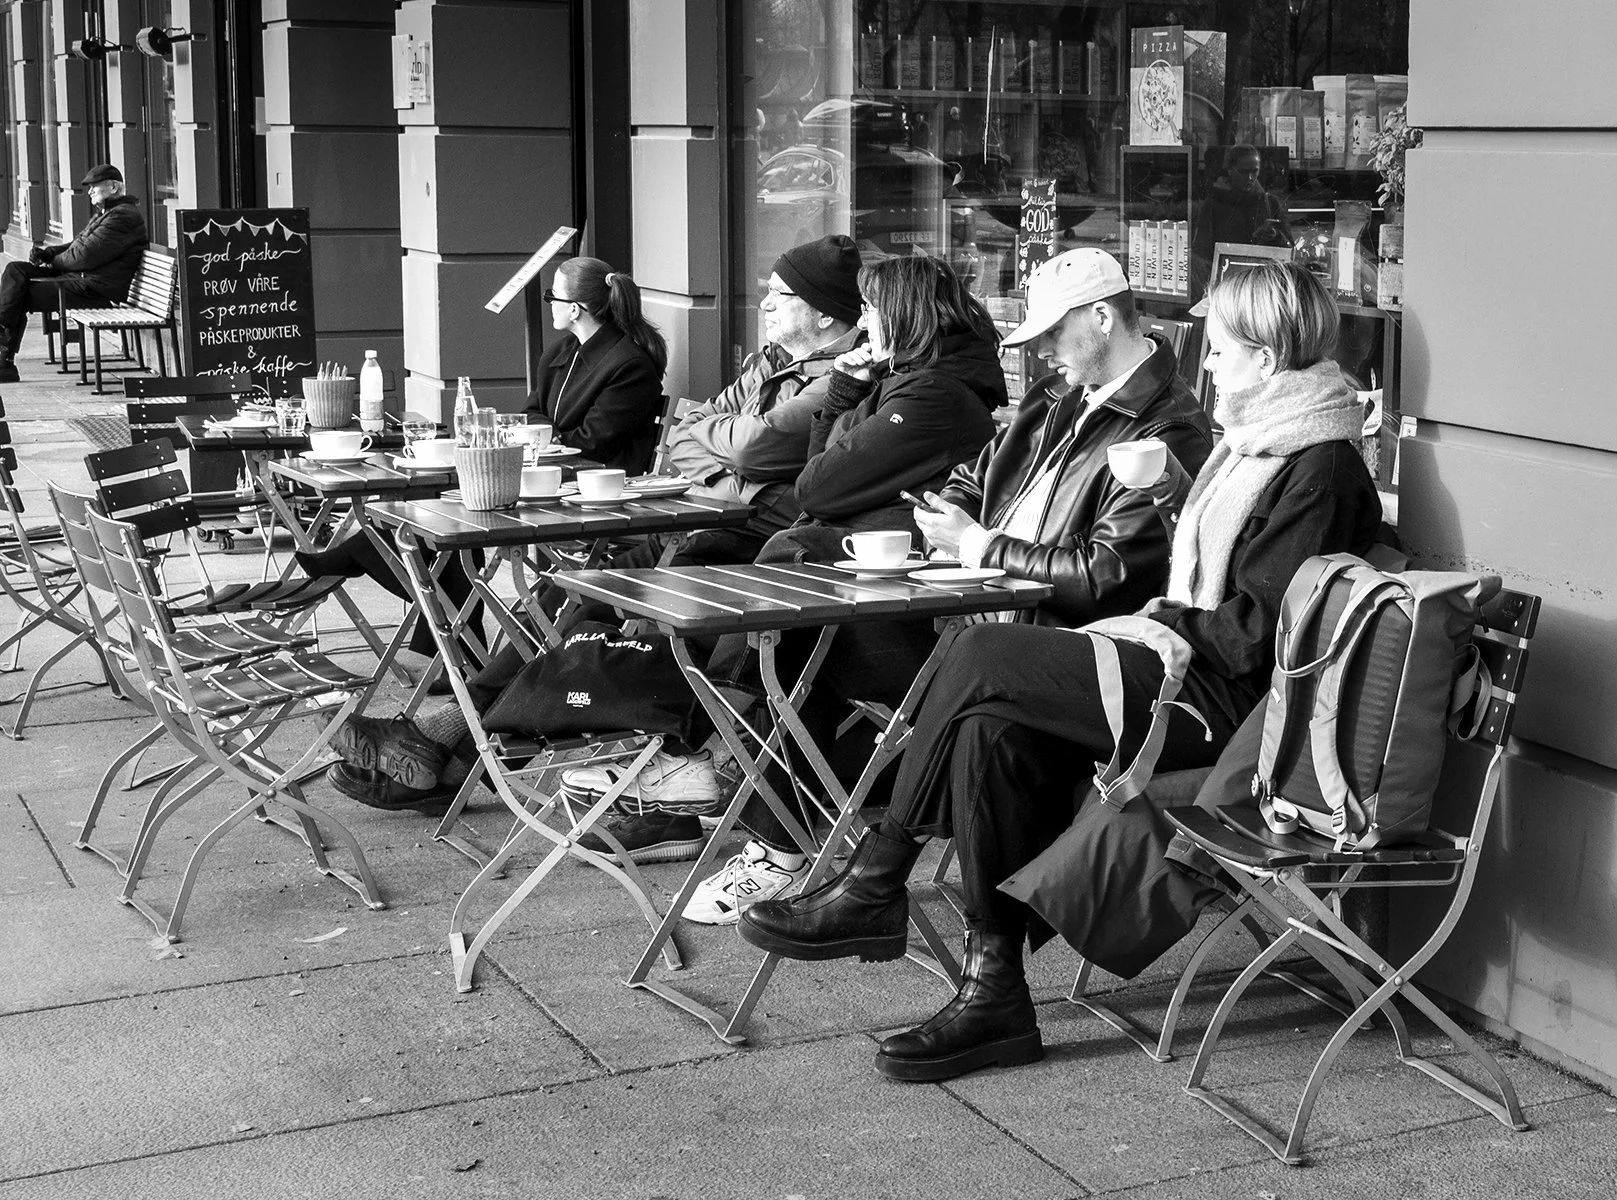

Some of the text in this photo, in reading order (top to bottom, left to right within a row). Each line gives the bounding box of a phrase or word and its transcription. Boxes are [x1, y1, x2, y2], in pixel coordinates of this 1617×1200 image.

[1142, 42, 1177, 53] PIZZA
[1026, 208, 1050, 232] GOD
[198, 242, 291, 274] god påske
[203, 273, 280, 296] PRØV VÅRE
[200, 291, 297, 326] spennende
[200, 325, 301, 346] PÅSKEPRODUKTER
[247, 345, 256, 359] &
[253, 354, 302, 378] kaffe
[567, 691, 589, 701] KARL
[738, 878, 761, 895] N
